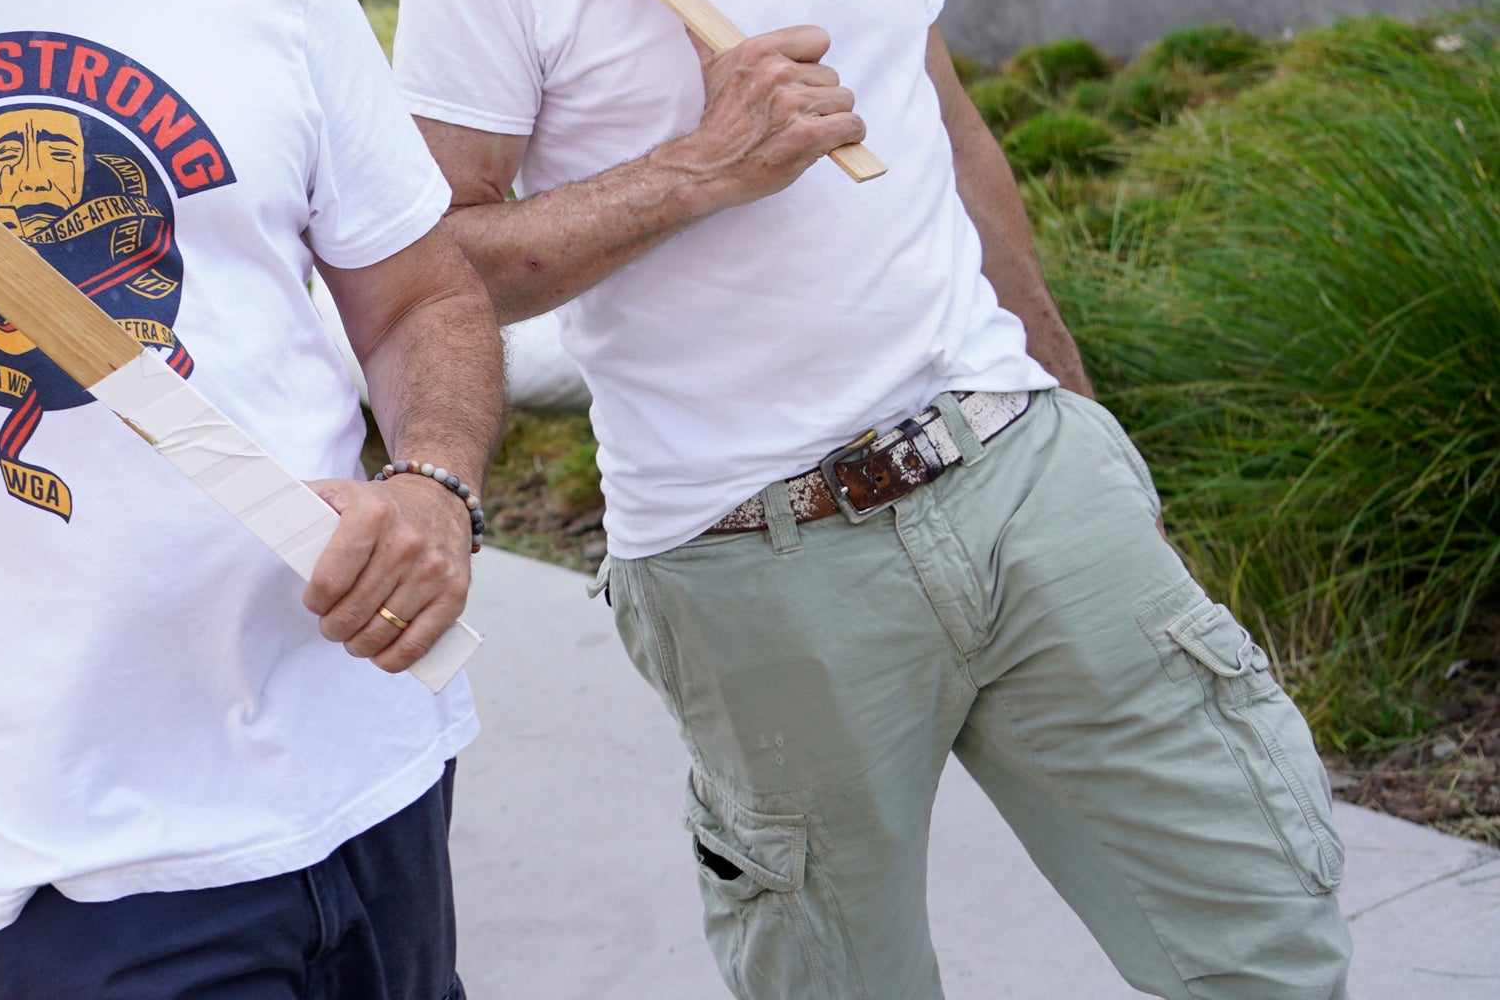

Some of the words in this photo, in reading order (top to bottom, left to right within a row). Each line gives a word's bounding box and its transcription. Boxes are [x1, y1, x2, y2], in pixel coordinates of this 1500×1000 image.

[58, 197, 135, 240] SAG-AFTRA
[8, 372, 31, 396] WG
[3, 464, 60, 507] WGA
